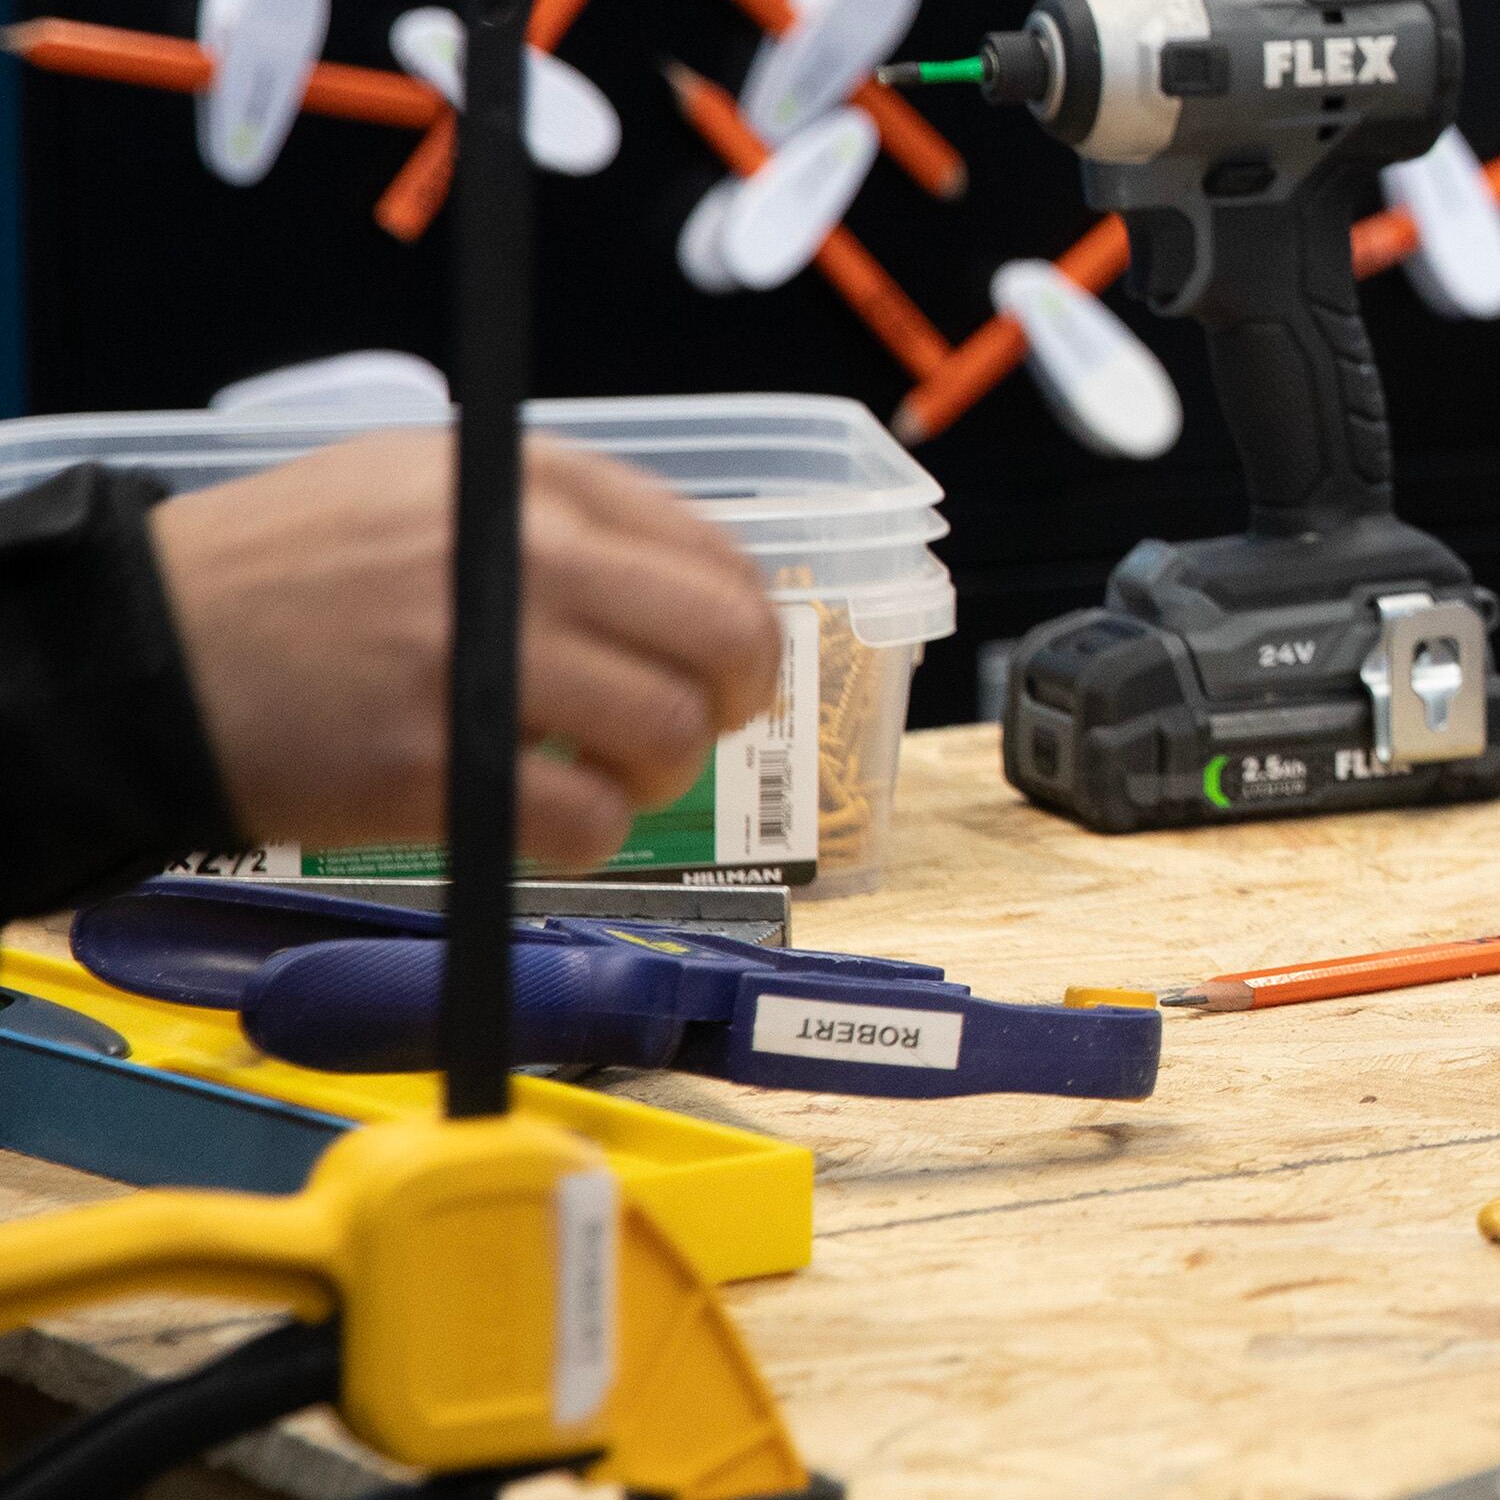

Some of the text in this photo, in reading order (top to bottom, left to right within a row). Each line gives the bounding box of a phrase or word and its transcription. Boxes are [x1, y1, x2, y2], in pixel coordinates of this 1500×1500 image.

[1262, 34, 1399, 90] FLEX
[1258, 639, 1316, 668] 24V
[795, 1017, 922, 1050] ROBERT
